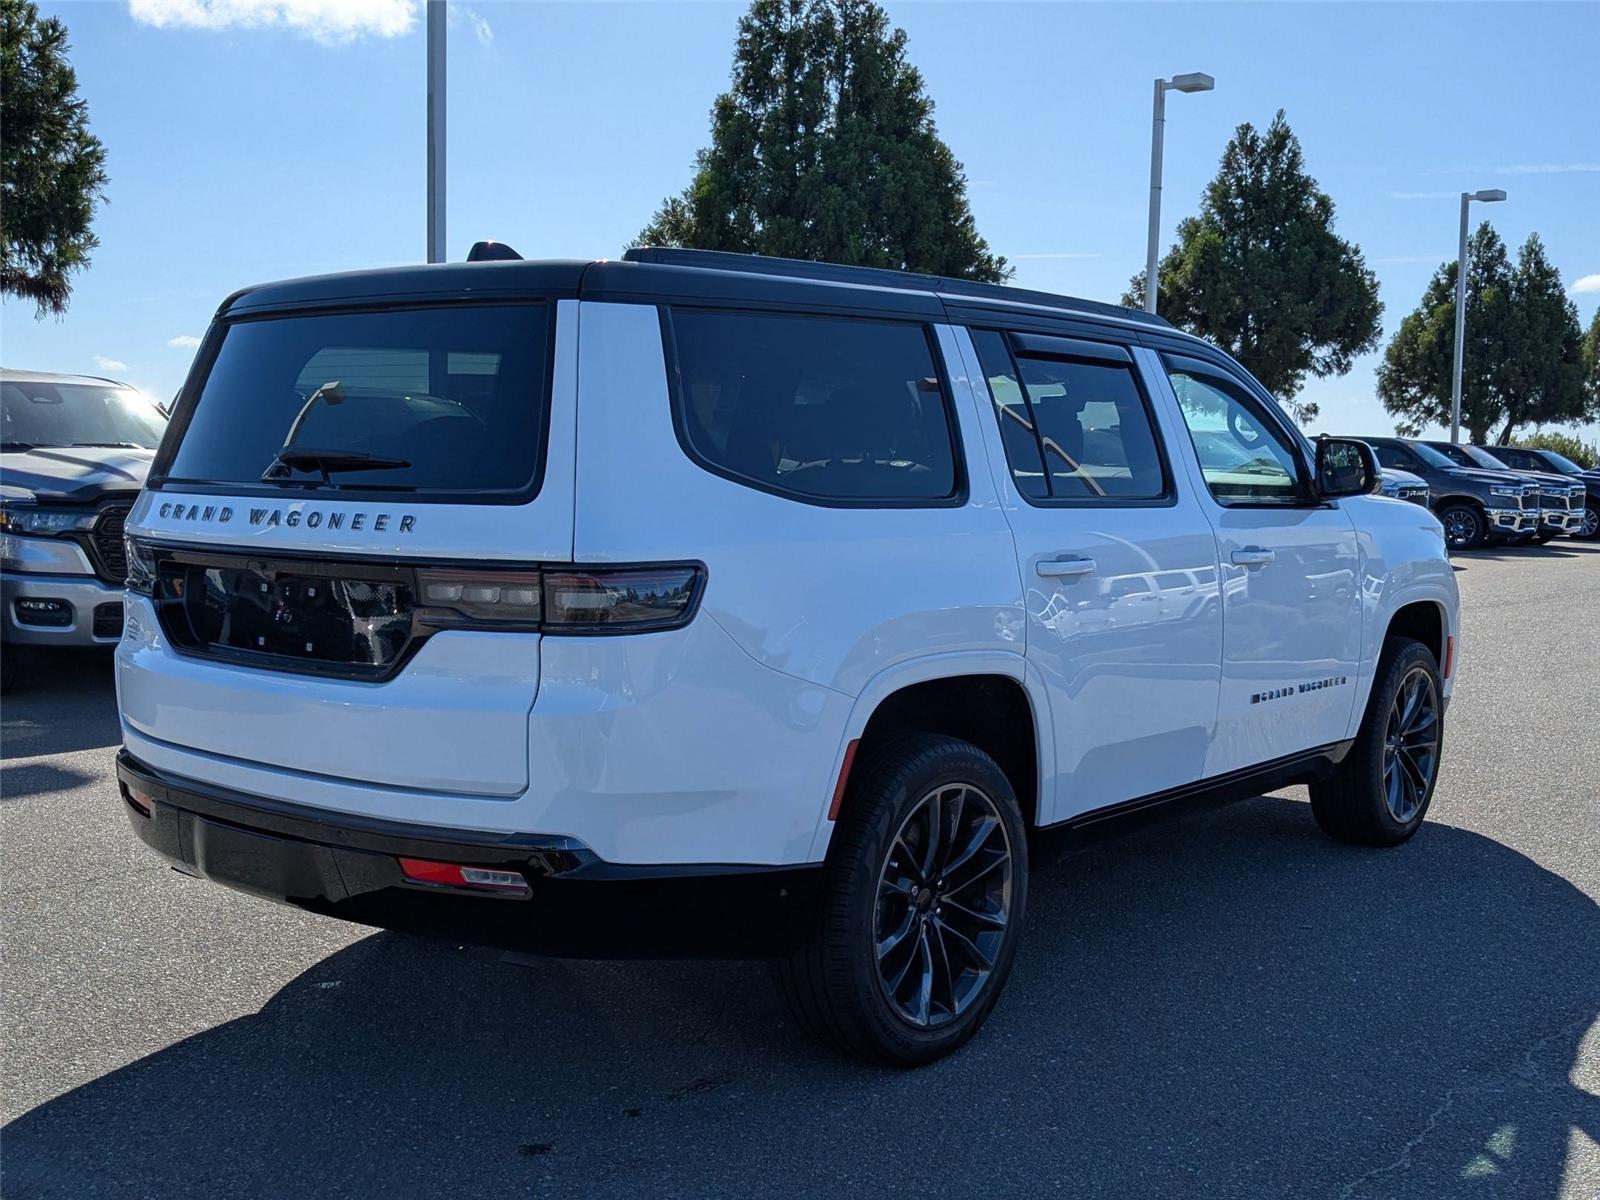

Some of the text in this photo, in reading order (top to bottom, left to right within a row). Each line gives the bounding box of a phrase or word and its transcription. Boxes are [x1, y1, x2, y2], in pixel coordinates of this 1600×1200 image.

[159, 502, 417, 533] GRAND WAGONEER
[1261, 677, 1346, 701] GRAND WAGONEER
